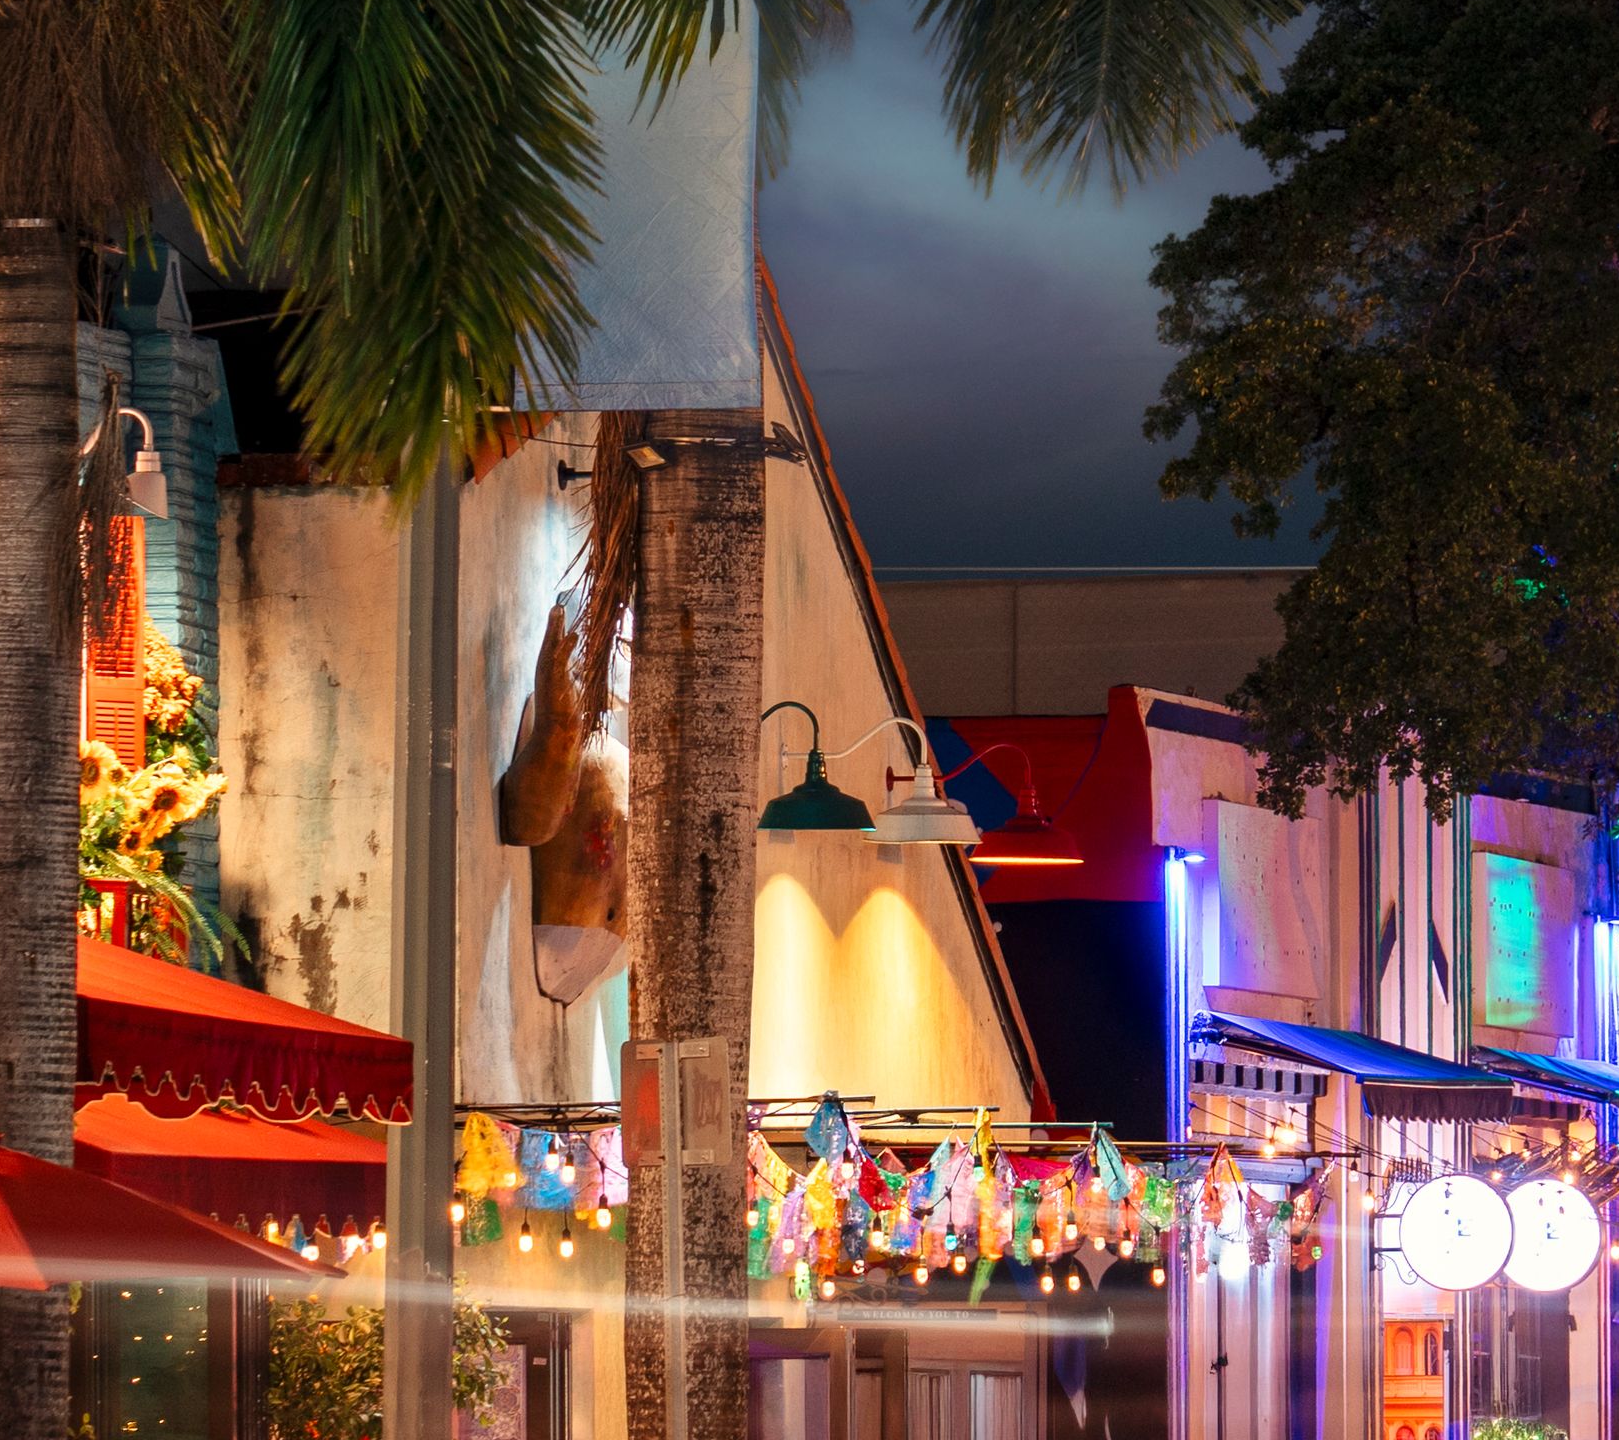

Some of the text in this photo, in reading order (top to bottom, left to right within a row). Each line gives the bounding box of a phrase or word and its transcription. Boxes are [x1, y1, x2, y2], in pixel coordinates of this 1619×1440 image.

[862, 1310, 970, 1319] WELCOMES YOU TO
